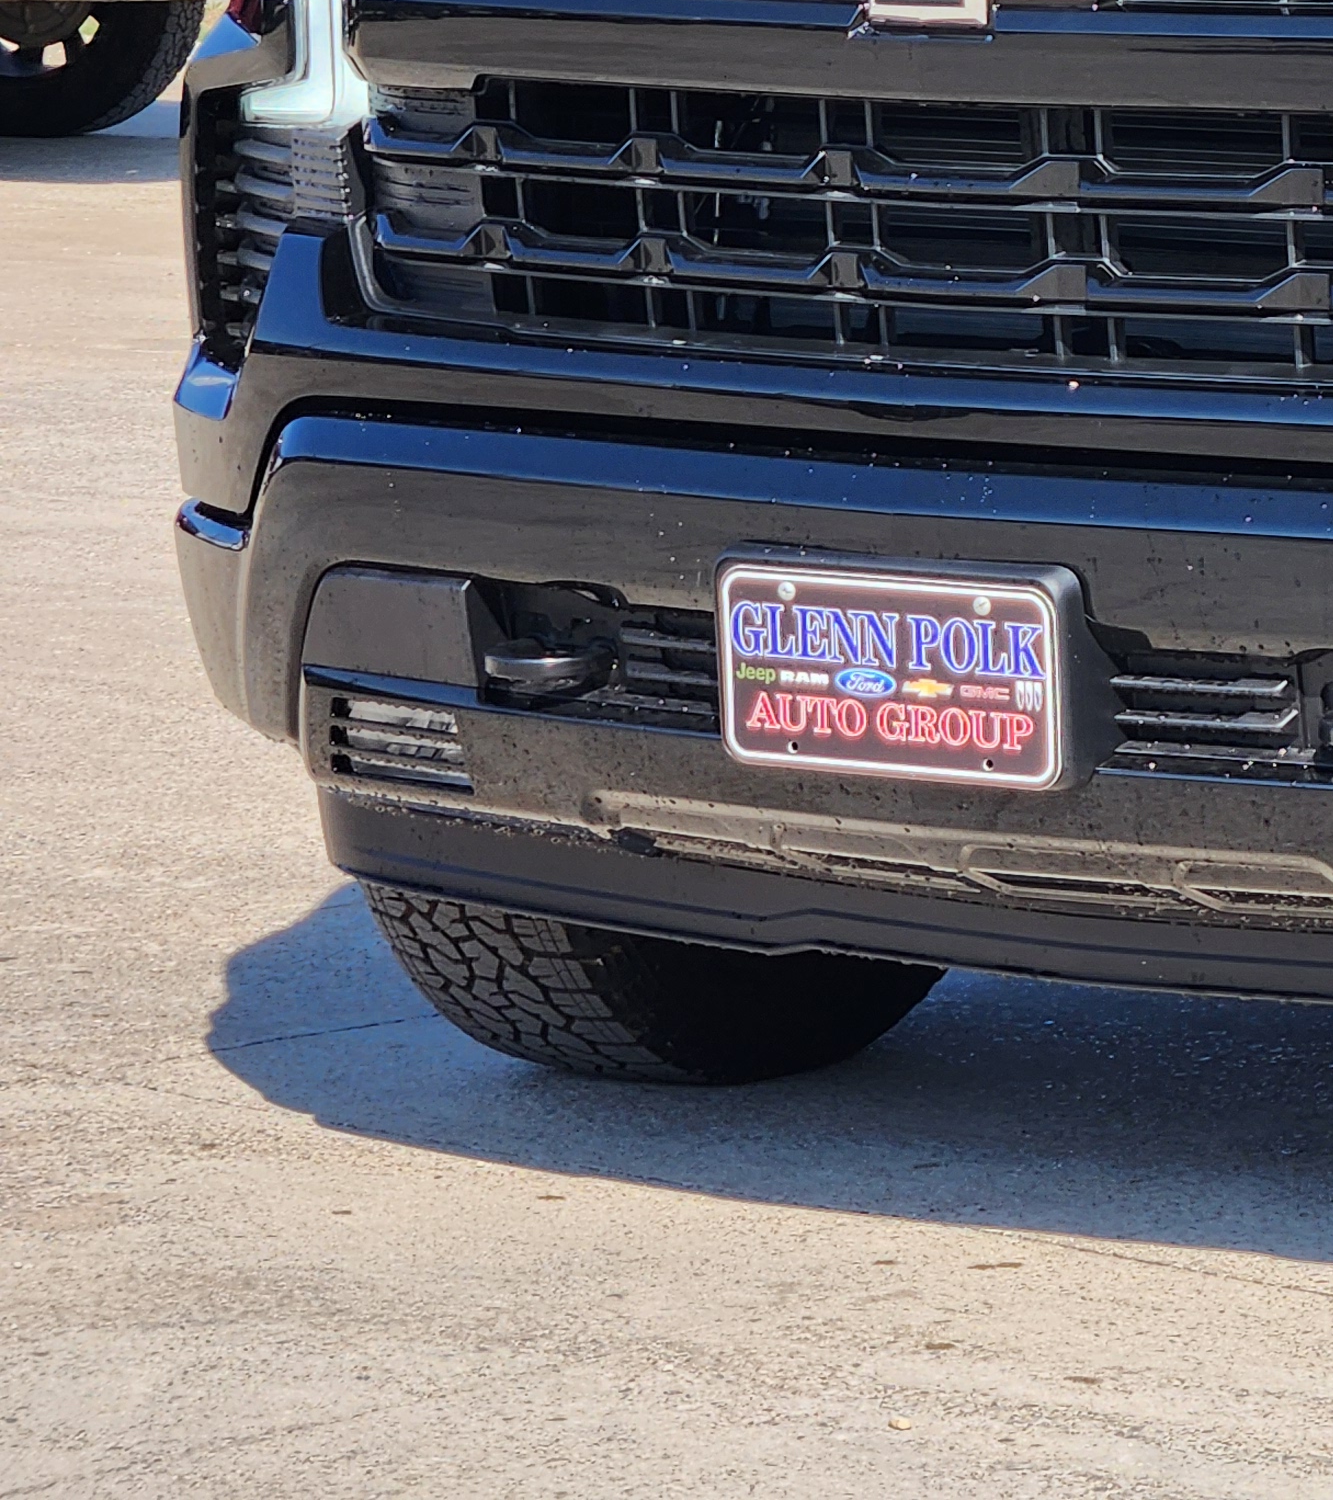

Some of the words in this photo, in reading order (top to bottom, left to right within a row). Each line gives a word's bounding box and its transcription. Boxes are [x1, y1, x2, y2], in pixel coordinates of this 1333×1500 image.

[731, 601, 899, 669] GLENN
[908, 615, 1047, 680] POLK
[736, 662, 776, 684] Jeep
[780, 670, 829, 685] RAM
[960, 685, 1010, 700] GMC
[746, 691, 867, 737] AUTO
[876, 703, 1034, 751] GROUP
